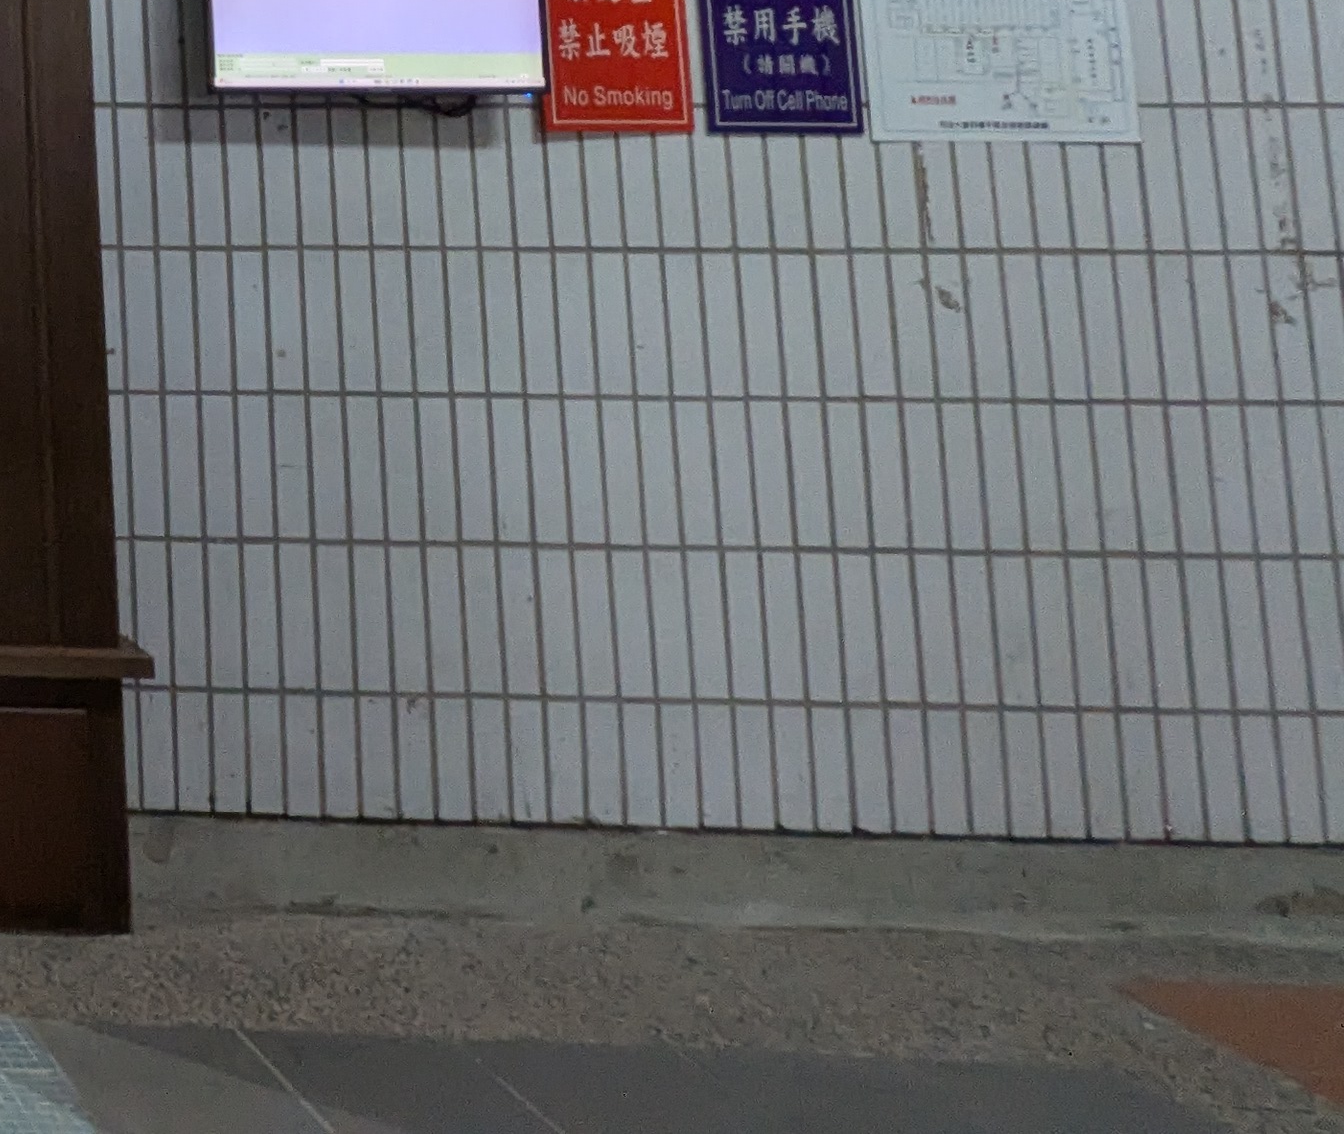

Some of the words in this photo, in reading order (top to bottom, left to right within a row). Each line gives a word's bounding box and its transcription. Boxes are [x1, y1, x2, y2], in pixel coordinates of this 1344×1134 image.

[558, 18, 669, 60] 禁止吸煙
[723, 4, 840, 46] 禁用手機
[564, 85, 589, 106] No
[594, 84, 674, 110] Smoking
[721, 89, 752, 110] Turn
[755, 89, 775, 110] Off
[777, 89, 804, 111] Cell
[805, 89, 849, 111] Phone
